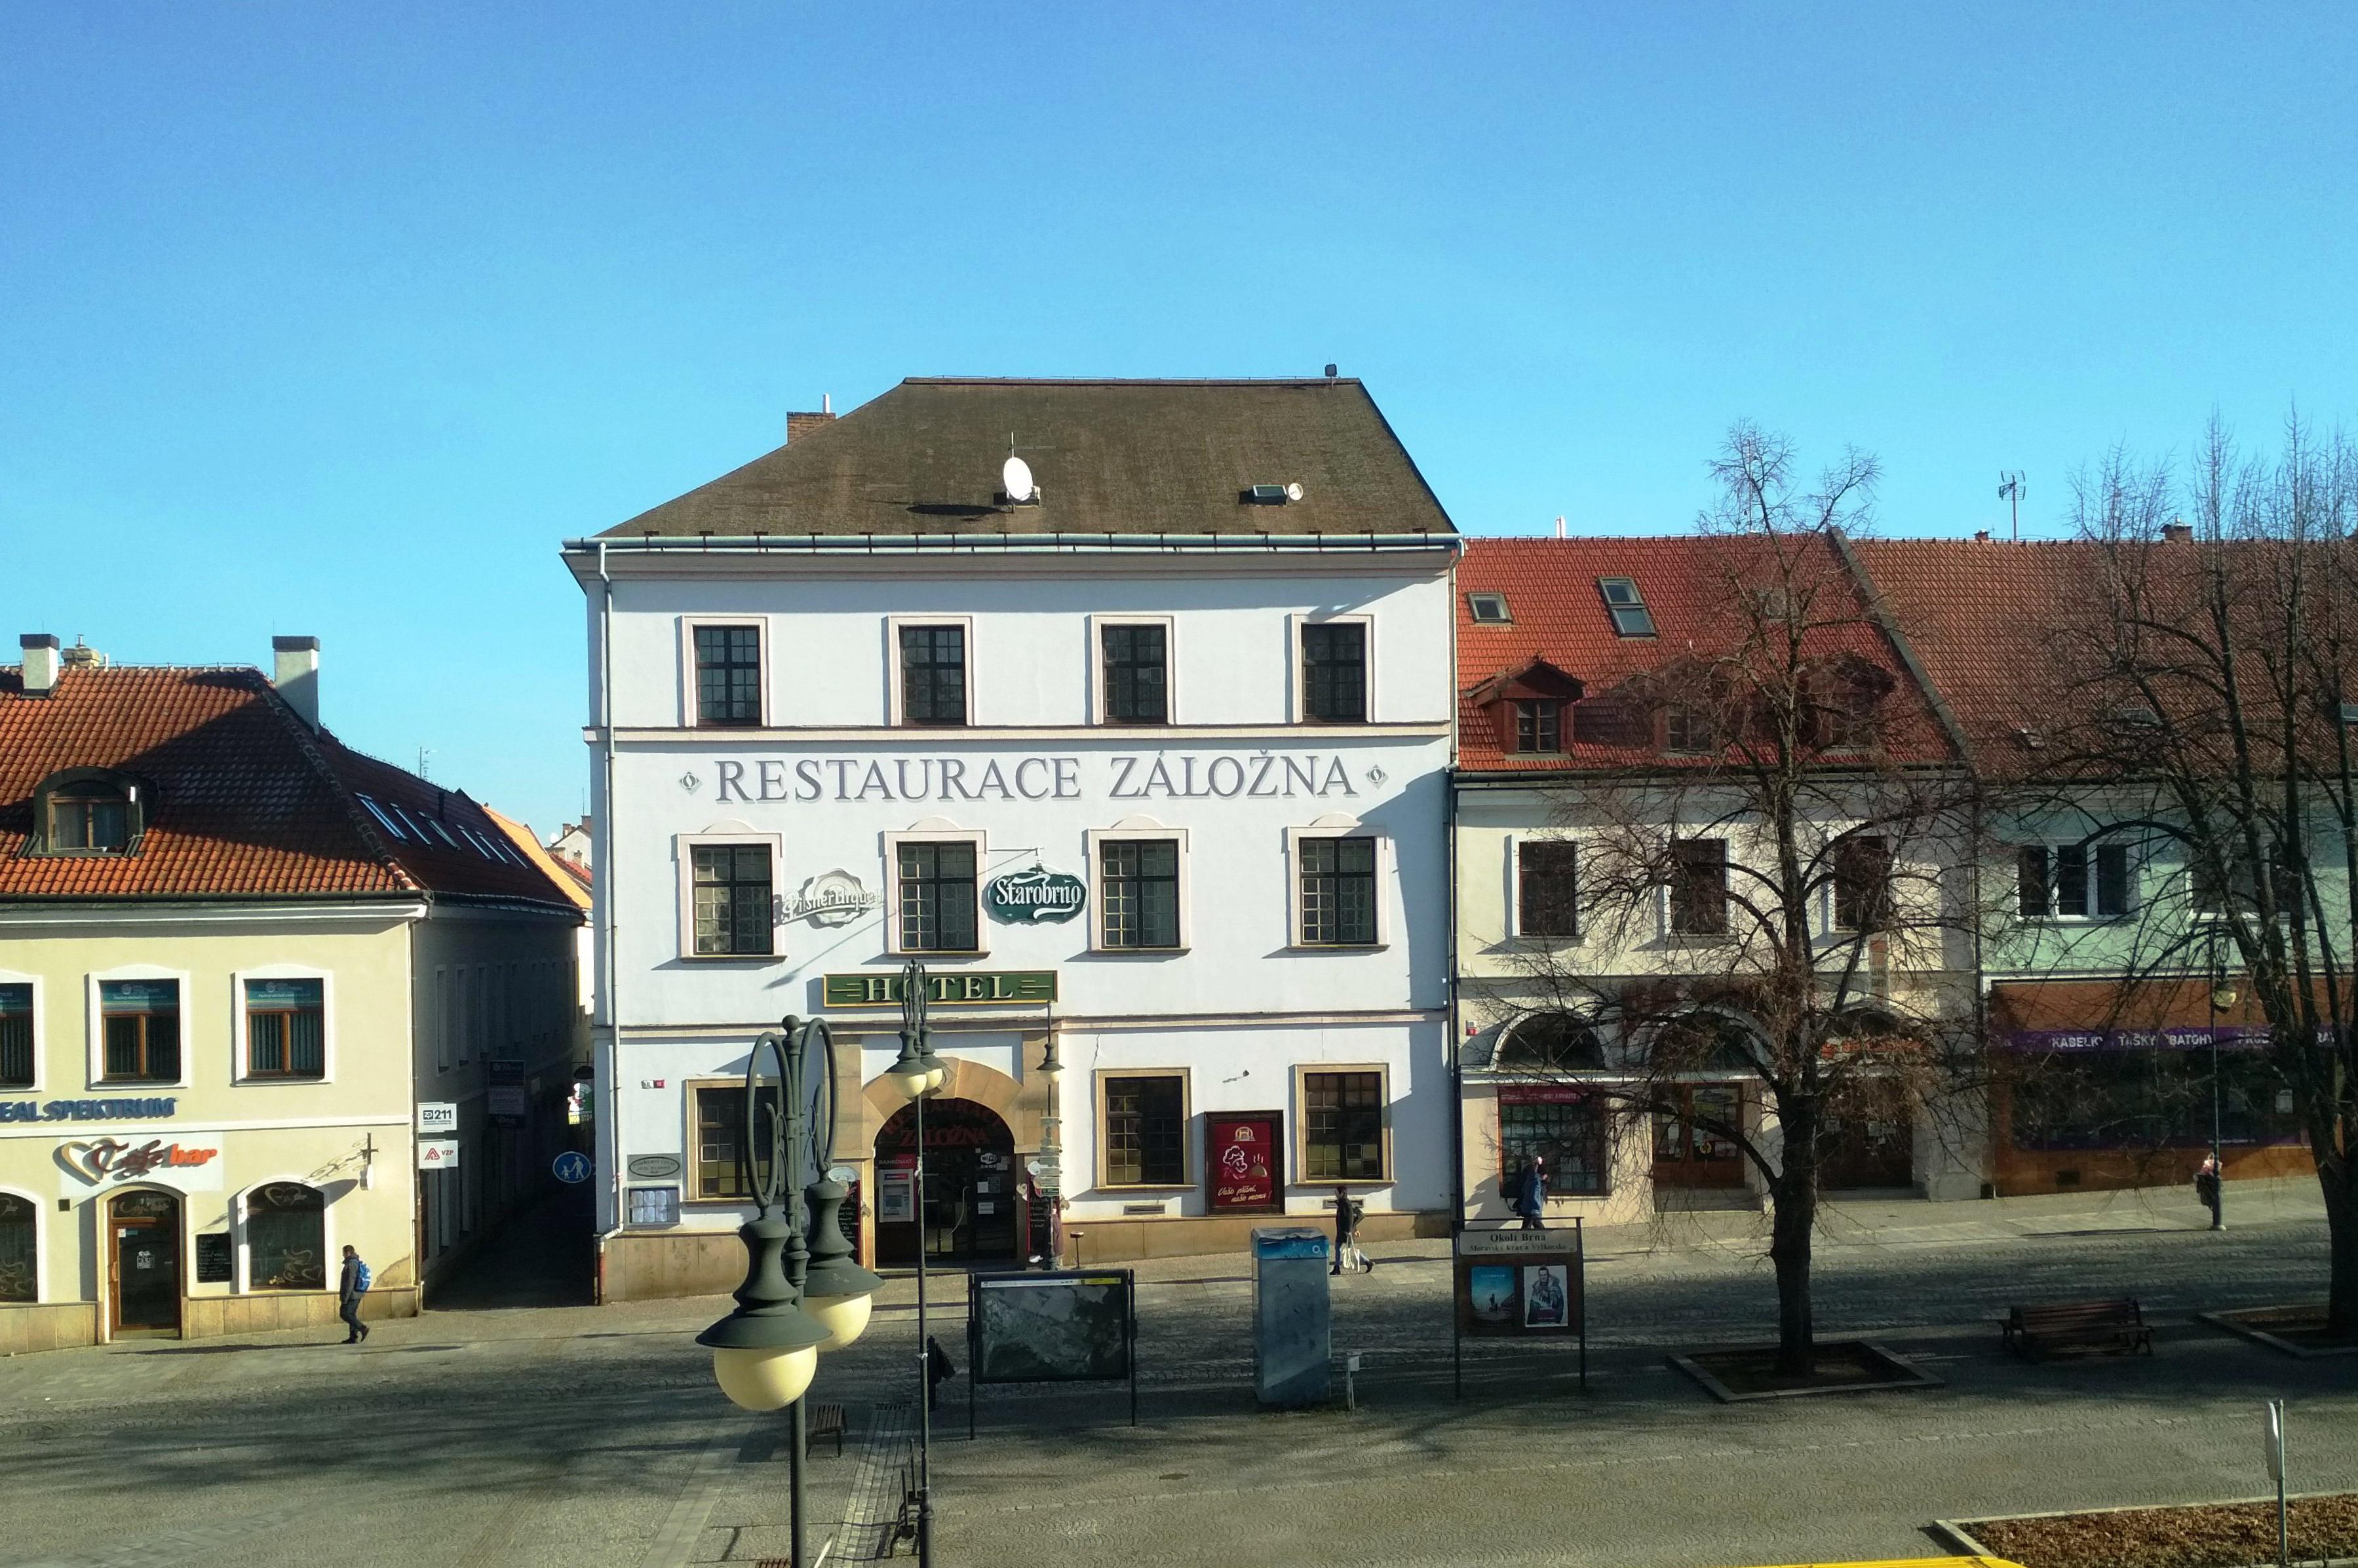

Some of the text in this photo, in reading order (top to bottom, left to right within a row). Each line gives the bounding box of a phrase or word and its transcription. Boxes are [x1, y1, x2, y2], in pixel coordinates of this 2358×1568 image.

[715, 749, 1361, 801] RESTAURACE ZÁLOŽNA
[782, 889, 836, 922] Pilsner
[996, 873, 1081, 919] Starobrno
[43, 1097, 175, 1122] SPEKTRUM
[435, 1109, 452, 1119] 211
[168, 1143, 218, 1164] bar
[1490, 1232, 1546, 1242] Okolí Brna
